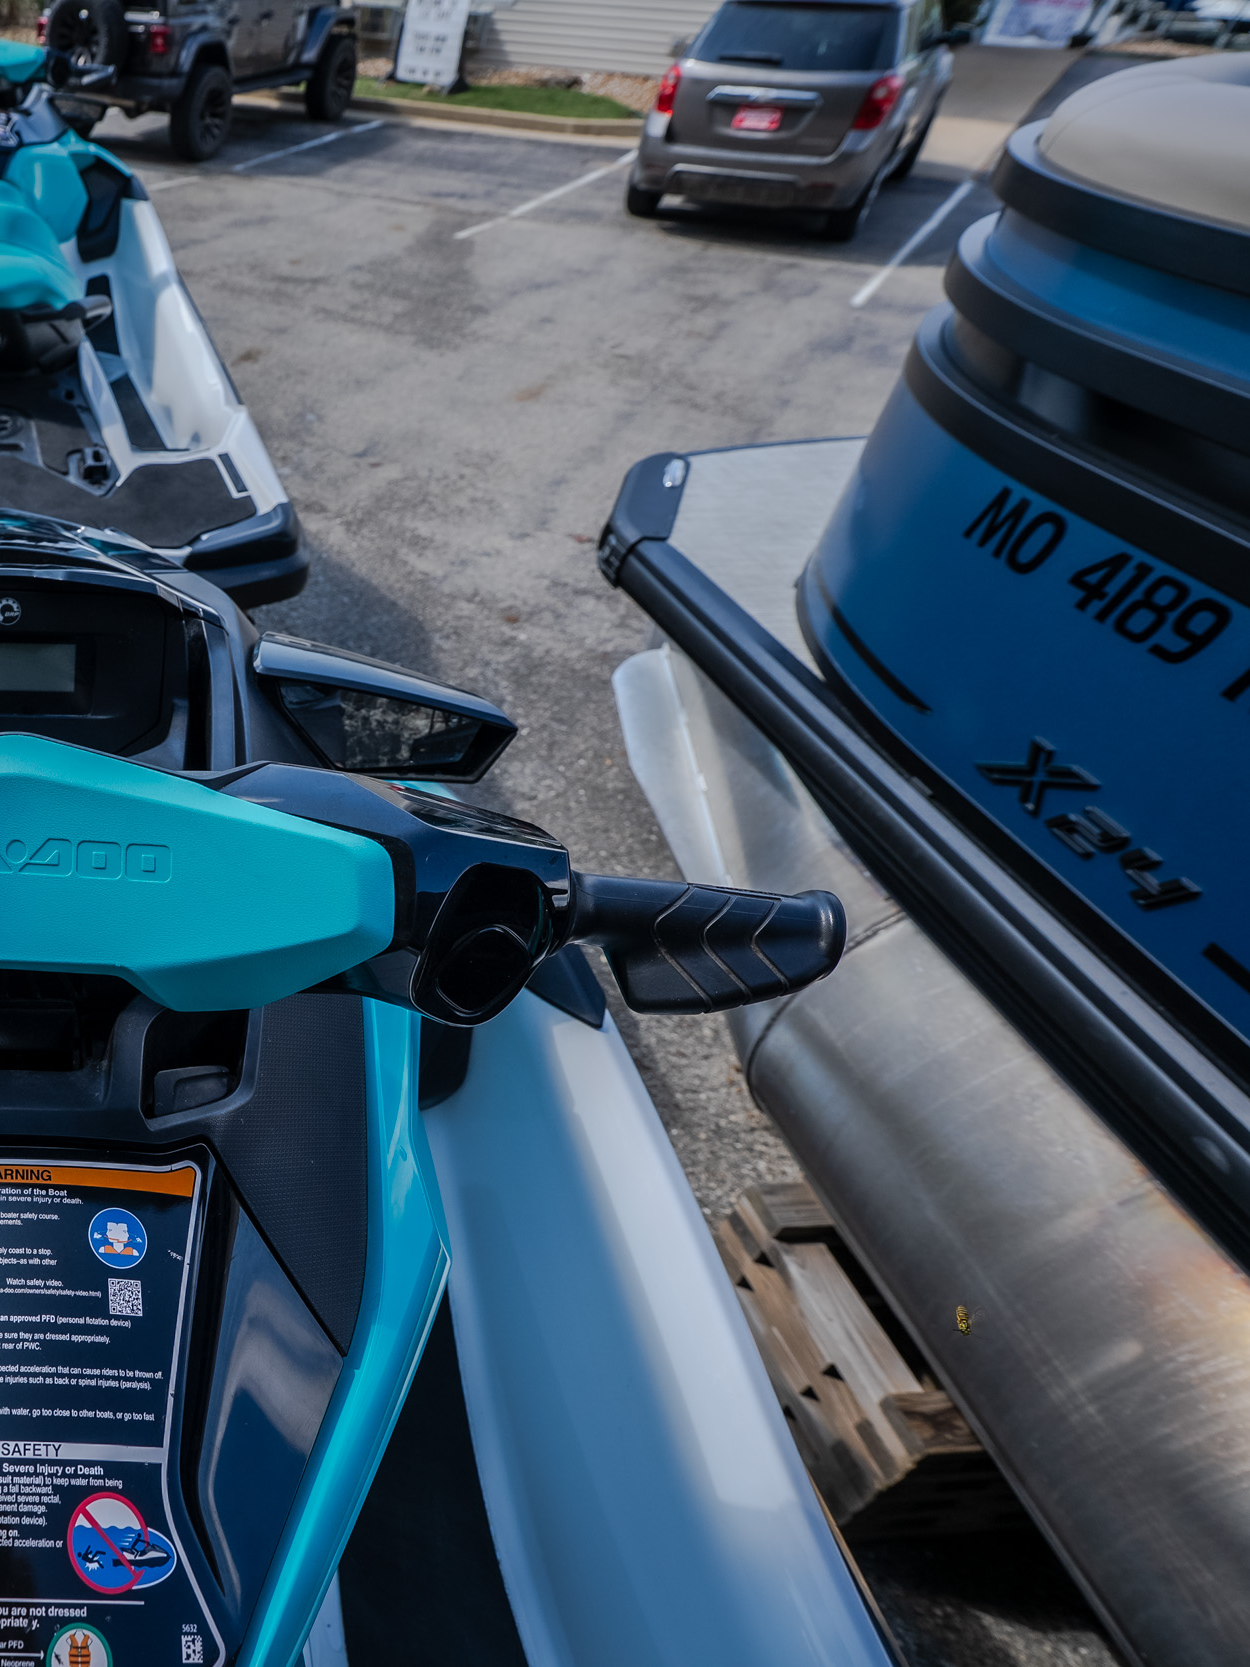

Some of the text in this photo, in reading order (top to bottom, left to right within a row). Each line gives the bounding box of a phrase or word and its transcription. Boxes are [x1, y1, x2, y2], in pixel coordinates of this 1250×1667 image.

[962, 485, 1233, 664] MO 4189
[24, 1187, 31, 1195] of
[34, 1187, 46, 1195] the
[49, 1187, 67, 1195] Boat
[6, 1276, 64, 1288] Watch safety video.
[10, 1313, 40, 1324] approved
[42, 1314, 55, 1323] PFD
[20, 1364, 56, 1373] acceleration
[58, 1365, 69, 1374] that
[102, 1367, 118, 1376] riders
[119, 1368, 125, 1376] to
[126, 1368, 134, 1377] be
[135, 1369, 153, 1378] thrown
[155, 1370, 164, 1379] off.
[1, 1443, 62, 1457] SAFETY
[3, 1463, 34, 1473] Severe
[37, 1463, 62, 1476] Injury
[66, 1466, 74, 1474] or
[78, 1464, 104, 1475] Death
[0, 1474, 11, 1483] suit
[45, 1475, 51, 1484] to
[53, 1475, 69, 1487] keep
[70, 1476, 88, 1485] water
[90, 1476, 104, 1486] from
[105, 1477, 122, 1489] being
[12, 1607, 26, 1616] are
[30, 1605, 45, 1616] not
[48, 1606, 86, 1617] dressed
[182, 1623, 198, 1633] 5632
[8, 1640, 24, 1649] PFD
